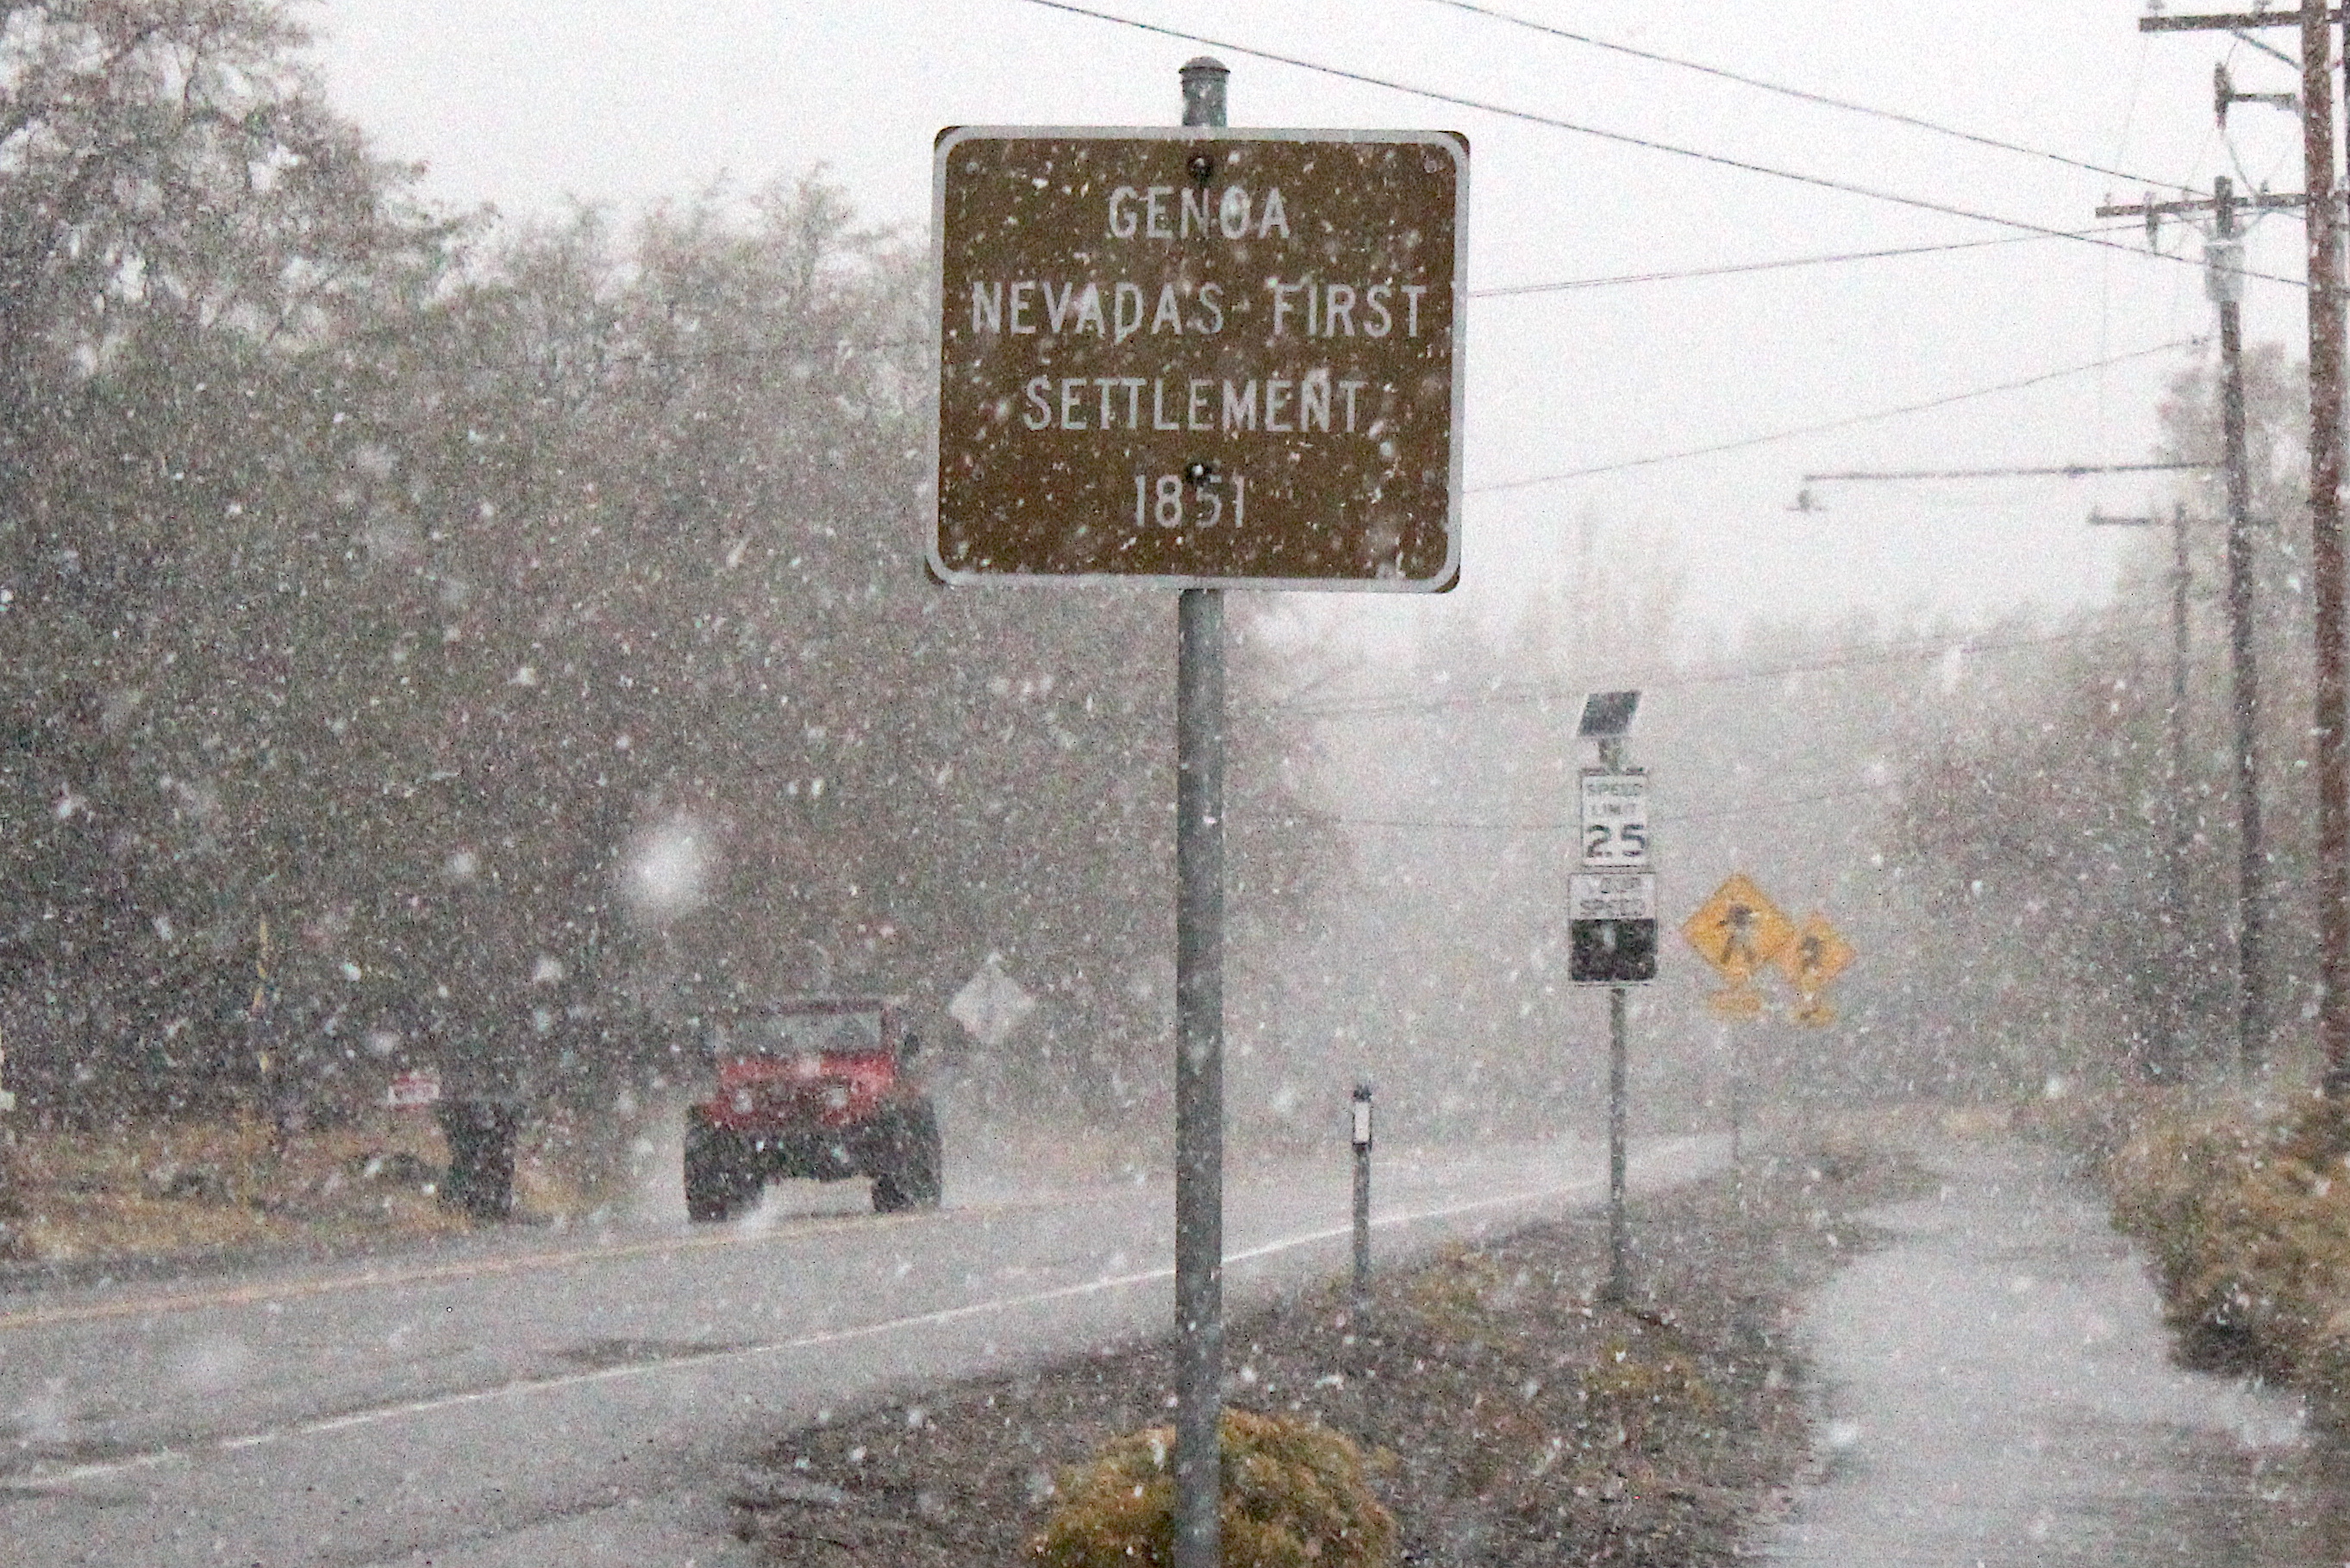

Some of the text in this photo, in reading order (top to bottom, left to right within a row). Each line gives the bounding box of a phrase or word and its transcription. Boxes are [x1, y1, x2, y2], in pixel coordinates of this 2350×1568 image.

[1109, 184, 1291, 240] GENOA
[1272, 284, 1427, 338] FIRST
[1023, 378, 1369, 433] SETTLEMENT
[1135, 474, 1244, 528] 1851
[1587, 824, 1646, 858] 25
